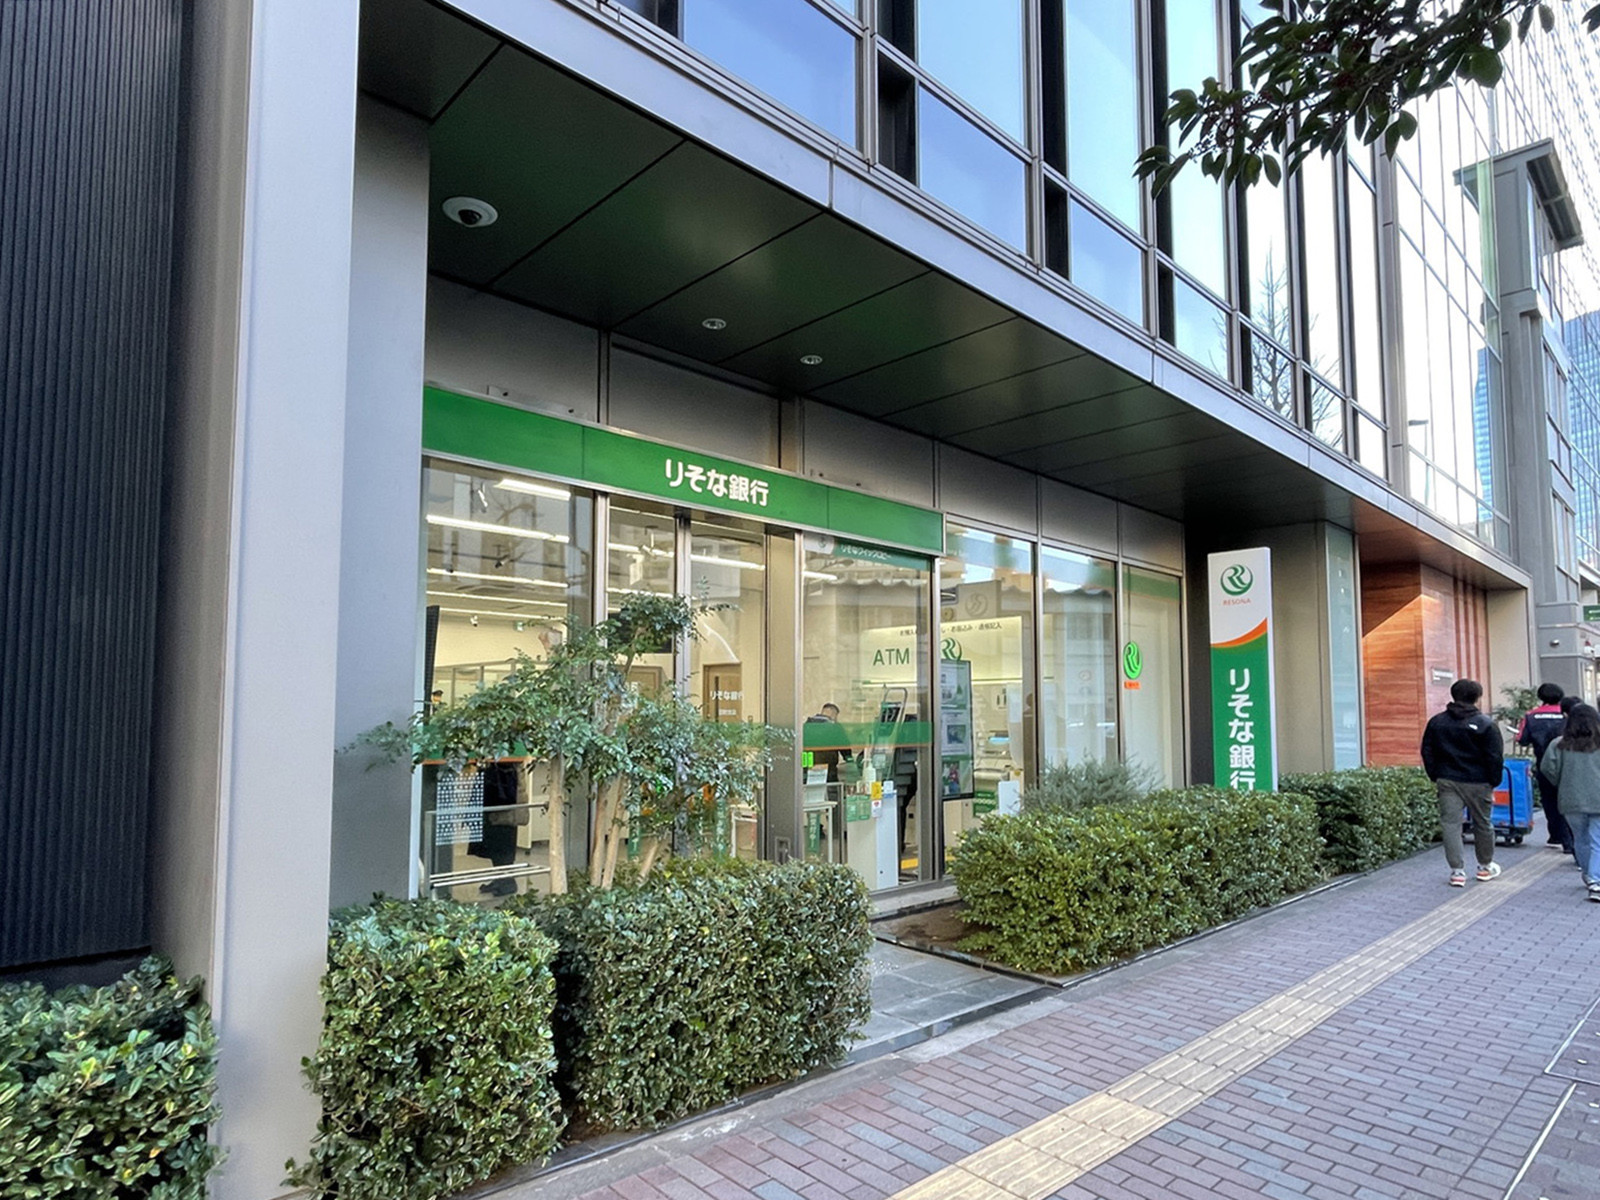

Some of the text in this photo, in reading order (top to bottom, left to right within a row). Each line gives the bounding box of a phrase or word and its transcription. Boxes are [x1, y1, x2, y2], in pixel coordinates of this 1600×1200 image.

[665, 458, 769, 507] りそな銀行
[1223, 598, 1251, 606] RESONA
[873, 648, 910, 666] ATM
[1227, 668, 1256, 792] りそな銀行
